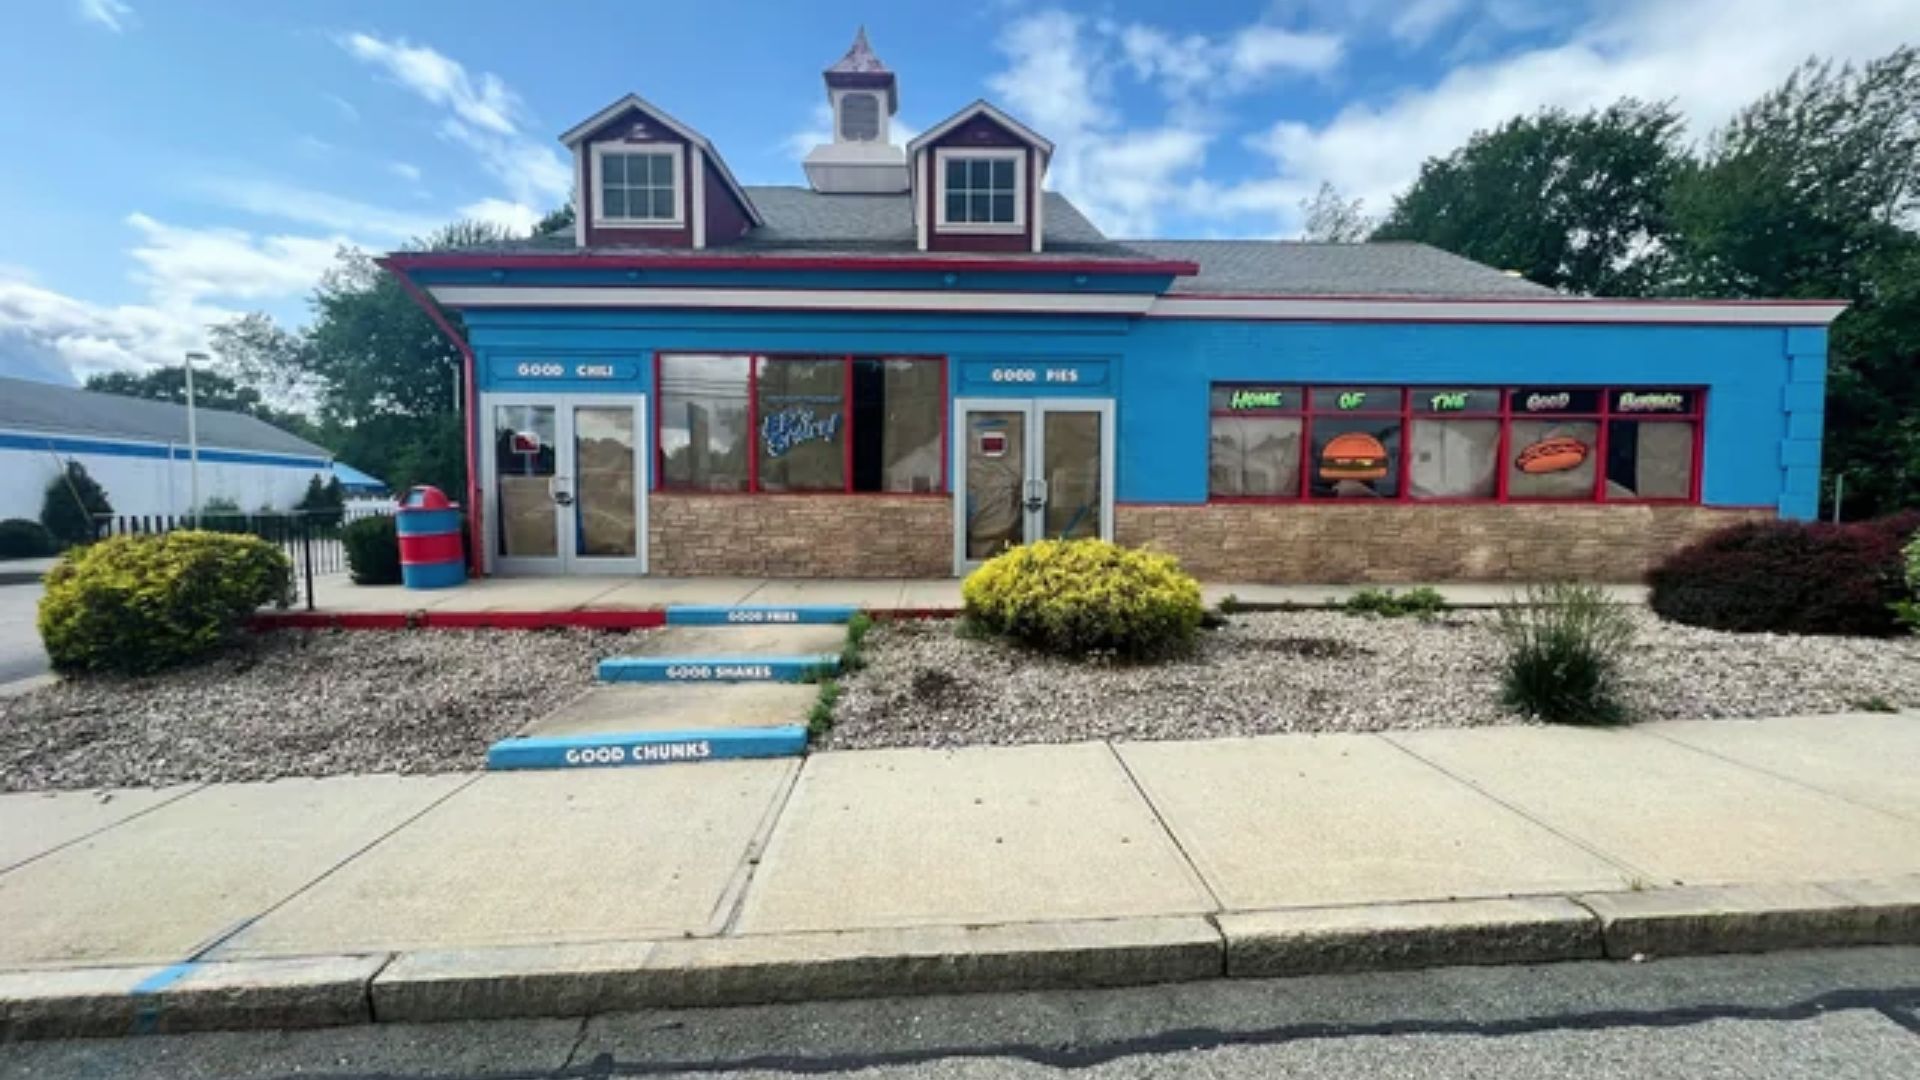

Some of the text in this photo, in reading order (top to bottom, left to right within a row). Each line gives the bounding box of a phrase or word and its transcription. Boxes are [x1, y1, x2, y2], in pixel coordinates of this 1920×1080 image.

[518, 363, 613, 377] GOOD CHILI
[992, 368, 1078, 381] GOOD PIES
[1340, 392, 1366, 409] OF
[728, 611, 763, 622] GOOD
[665, 665, 772, 679] GOOD SHAKES
[566, 740, 711, 763] GOOD CHUNKS
